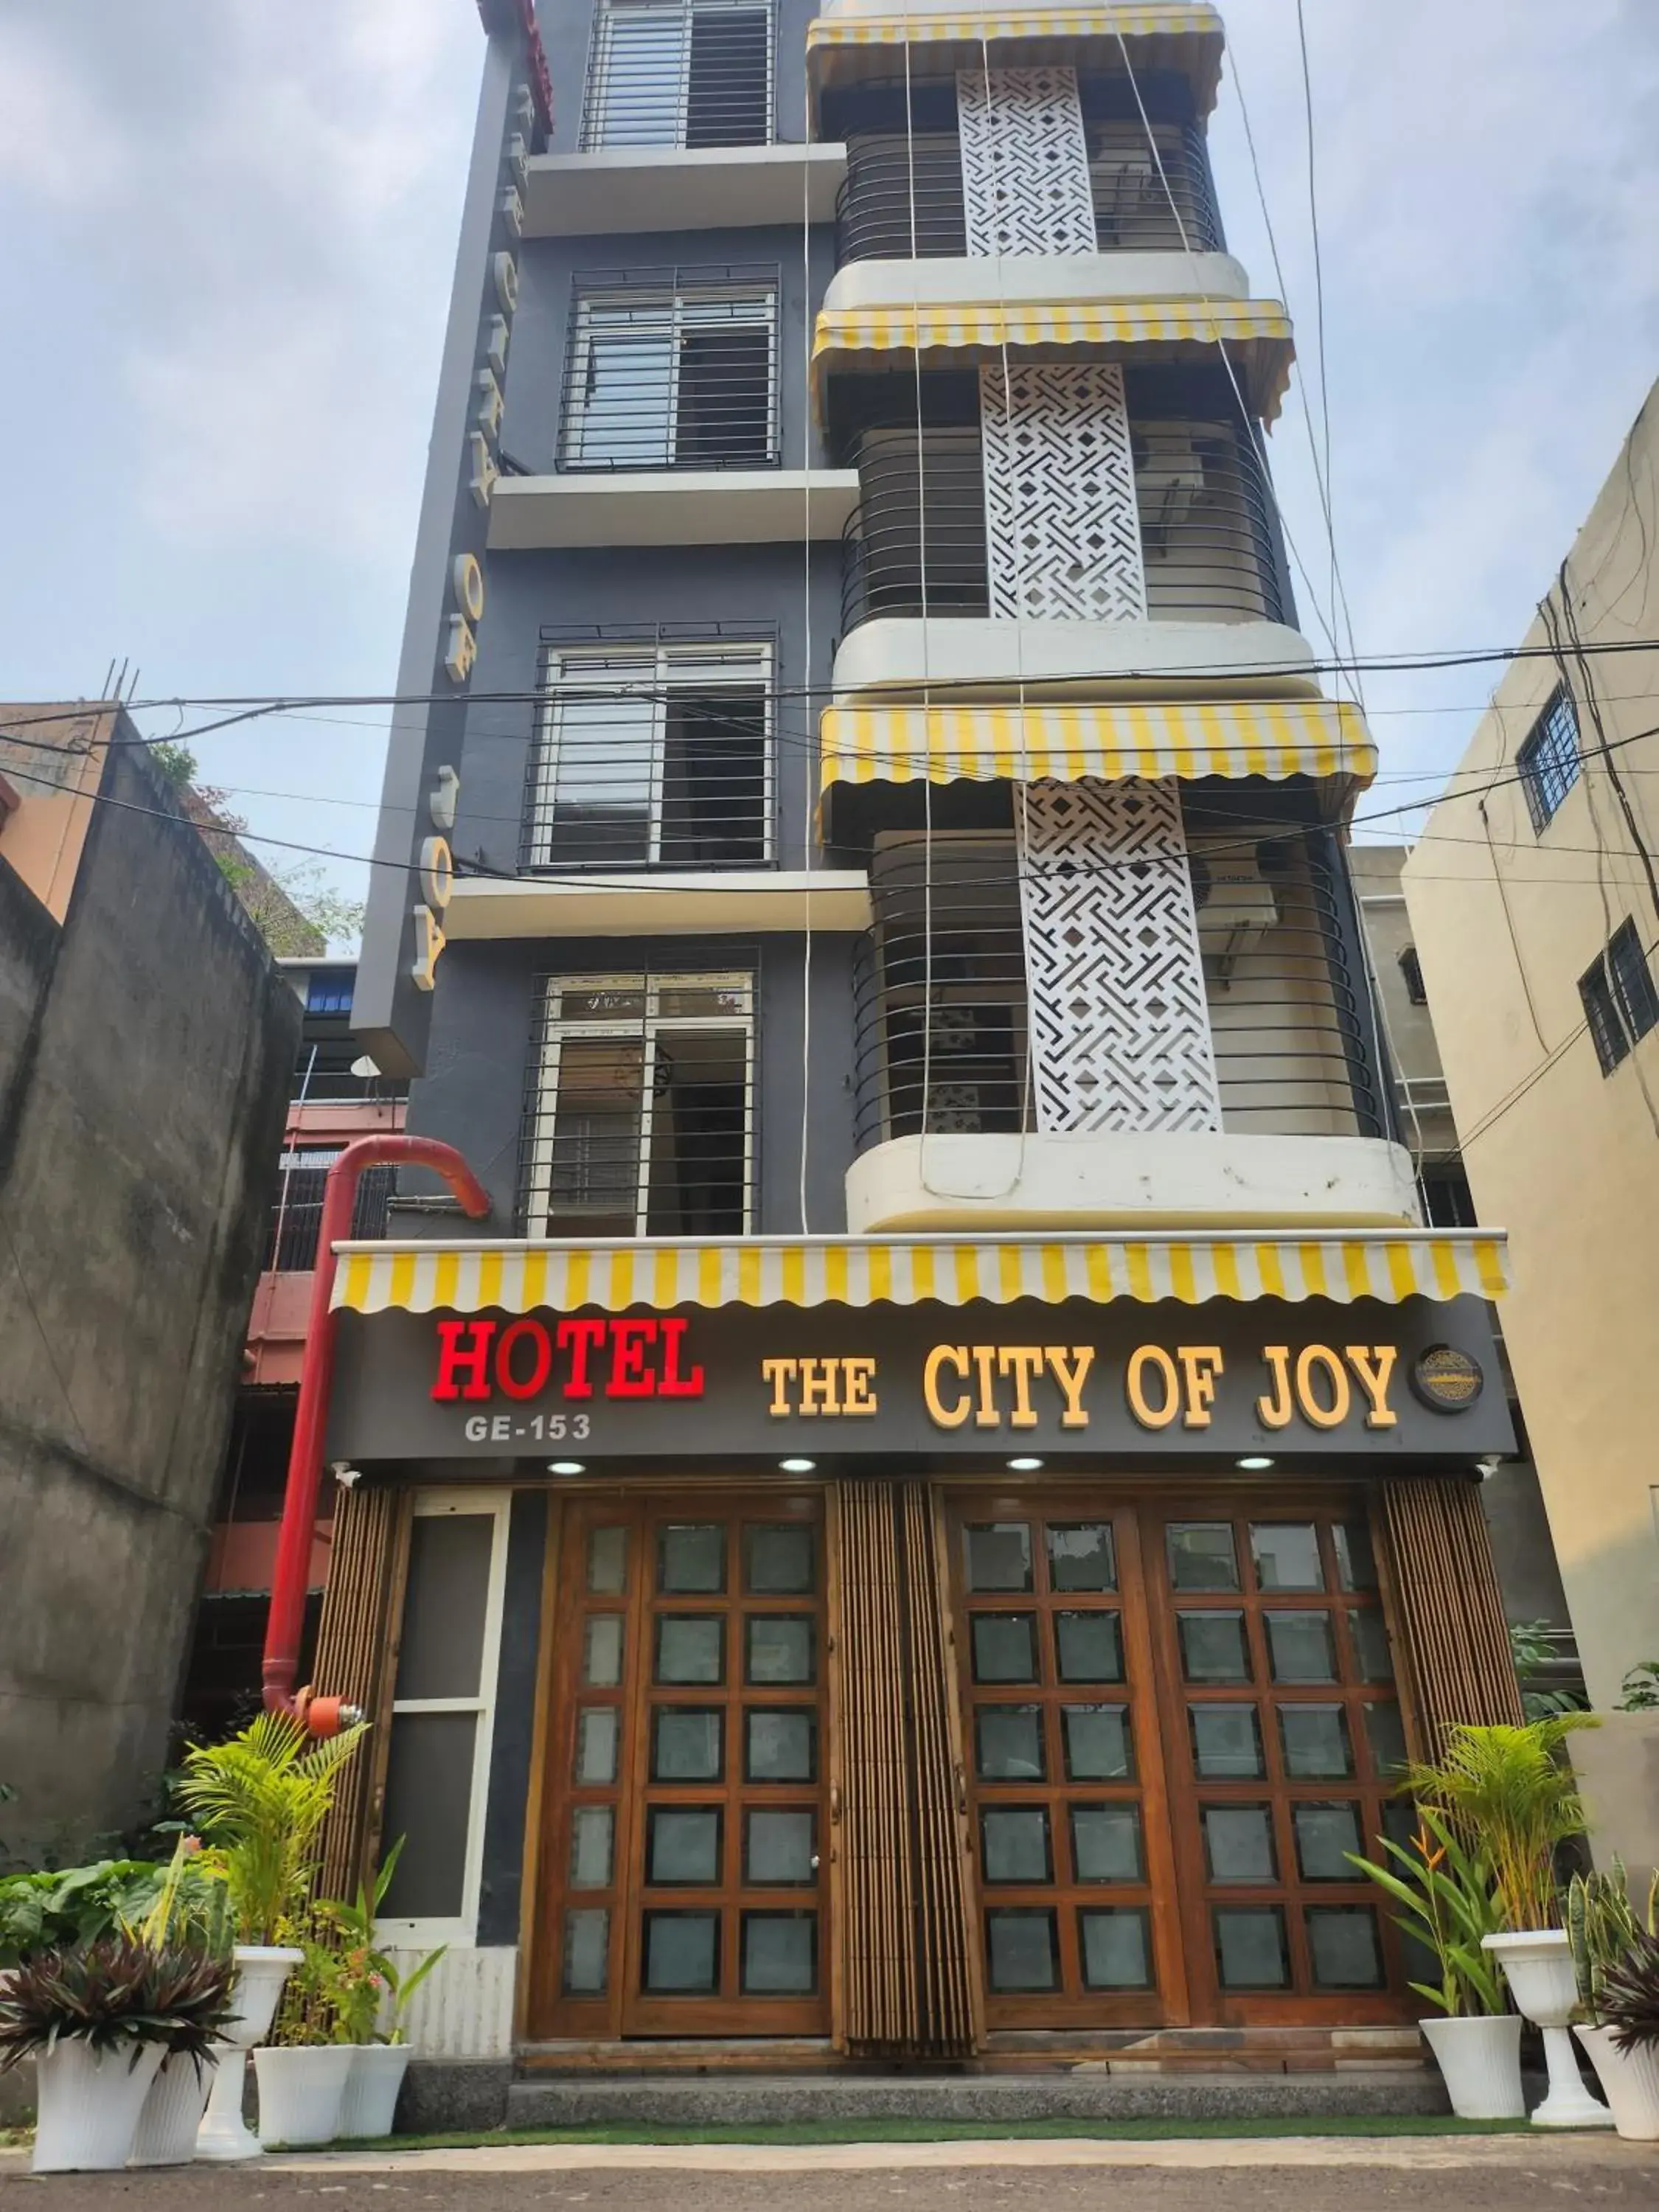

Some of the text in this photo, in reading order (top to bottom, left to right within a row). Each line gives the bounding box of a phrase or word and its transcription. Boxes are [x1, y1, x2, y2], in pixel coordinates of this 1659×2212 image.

[412, 765, 460, 991] JOY
[431, 1318, 1399, 1429] HOTEL THE CITY OF JOY
[465, 1413, 591, 1441] GE-153
